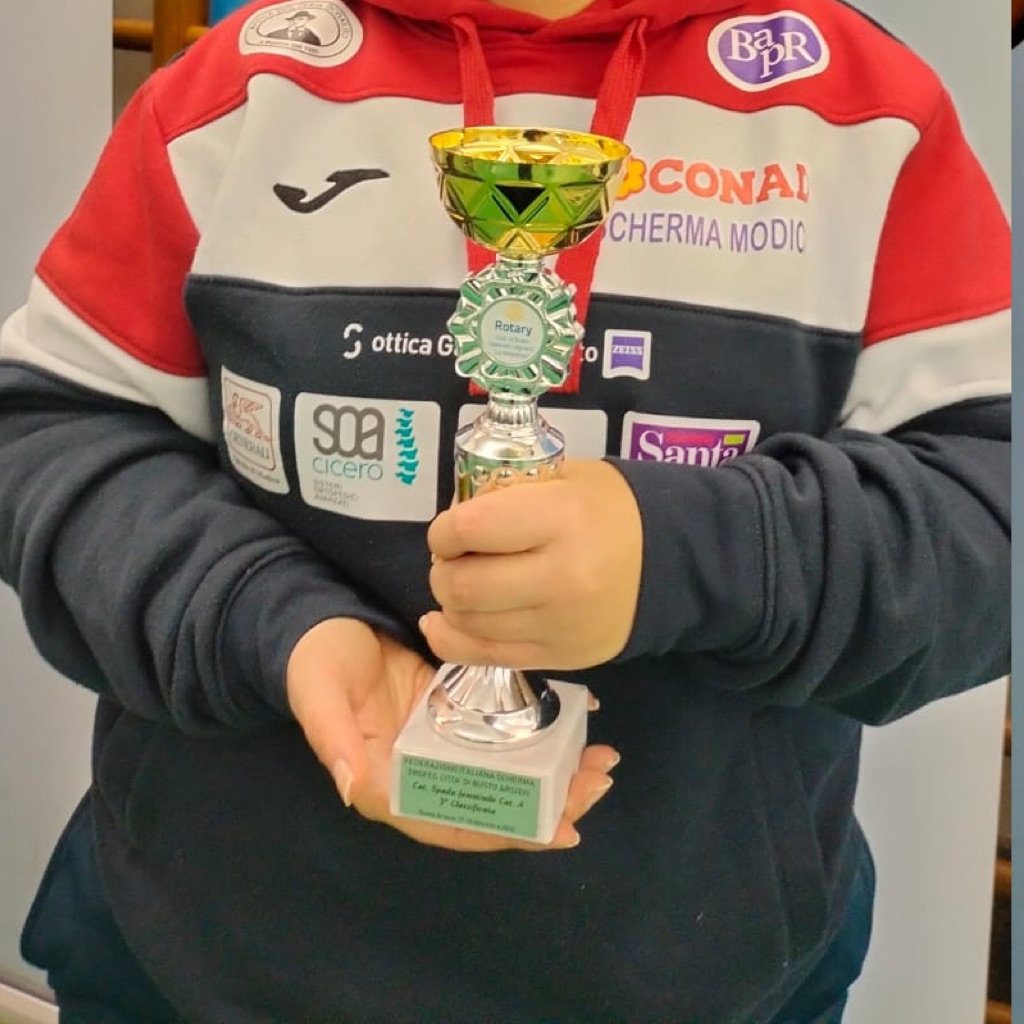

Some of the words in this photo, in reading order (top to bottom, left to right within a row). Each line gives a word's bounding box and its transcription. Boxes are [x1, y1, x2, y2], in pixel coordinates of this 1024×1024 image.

[602, 211, 722, 251] CHERMA
[730, 218, 808, 253] MODIC
[495, 320, 533, 337] Rotary
[372, 332, 433, 356] ottica
[612, 345, 643, 356] ZEISS
[312, 457, 384, 481] cicero
